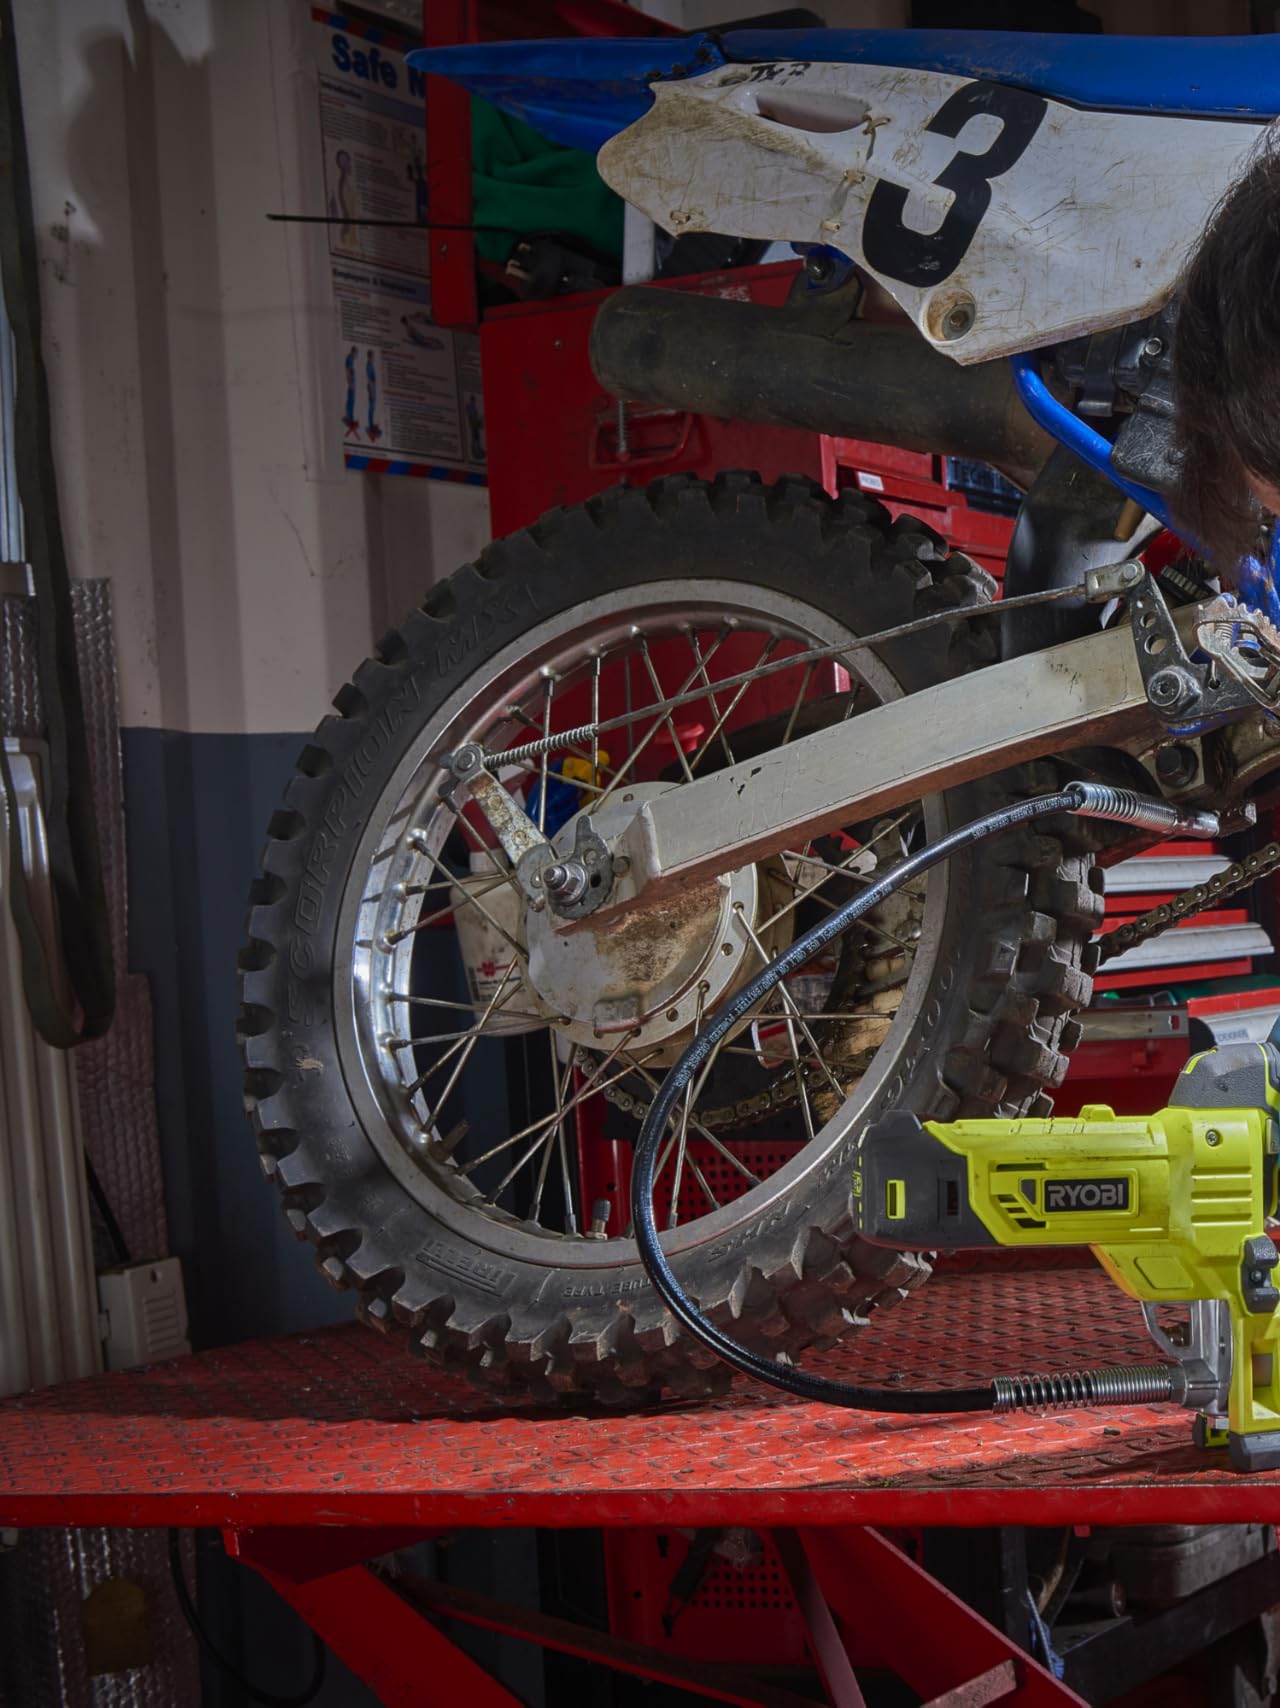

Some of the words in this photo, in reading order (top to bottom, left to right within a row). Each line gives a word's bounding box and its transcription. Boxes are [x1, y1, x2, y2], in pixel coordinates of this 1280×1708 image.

[331, 33, 398, 89] Safe
[861, 79, 1049, 289] 3
[787, 948, 807, 967] ONLY
[805, 938, 821, 953] USE
[1047, 1183, 1124, 1208] RYOBI
